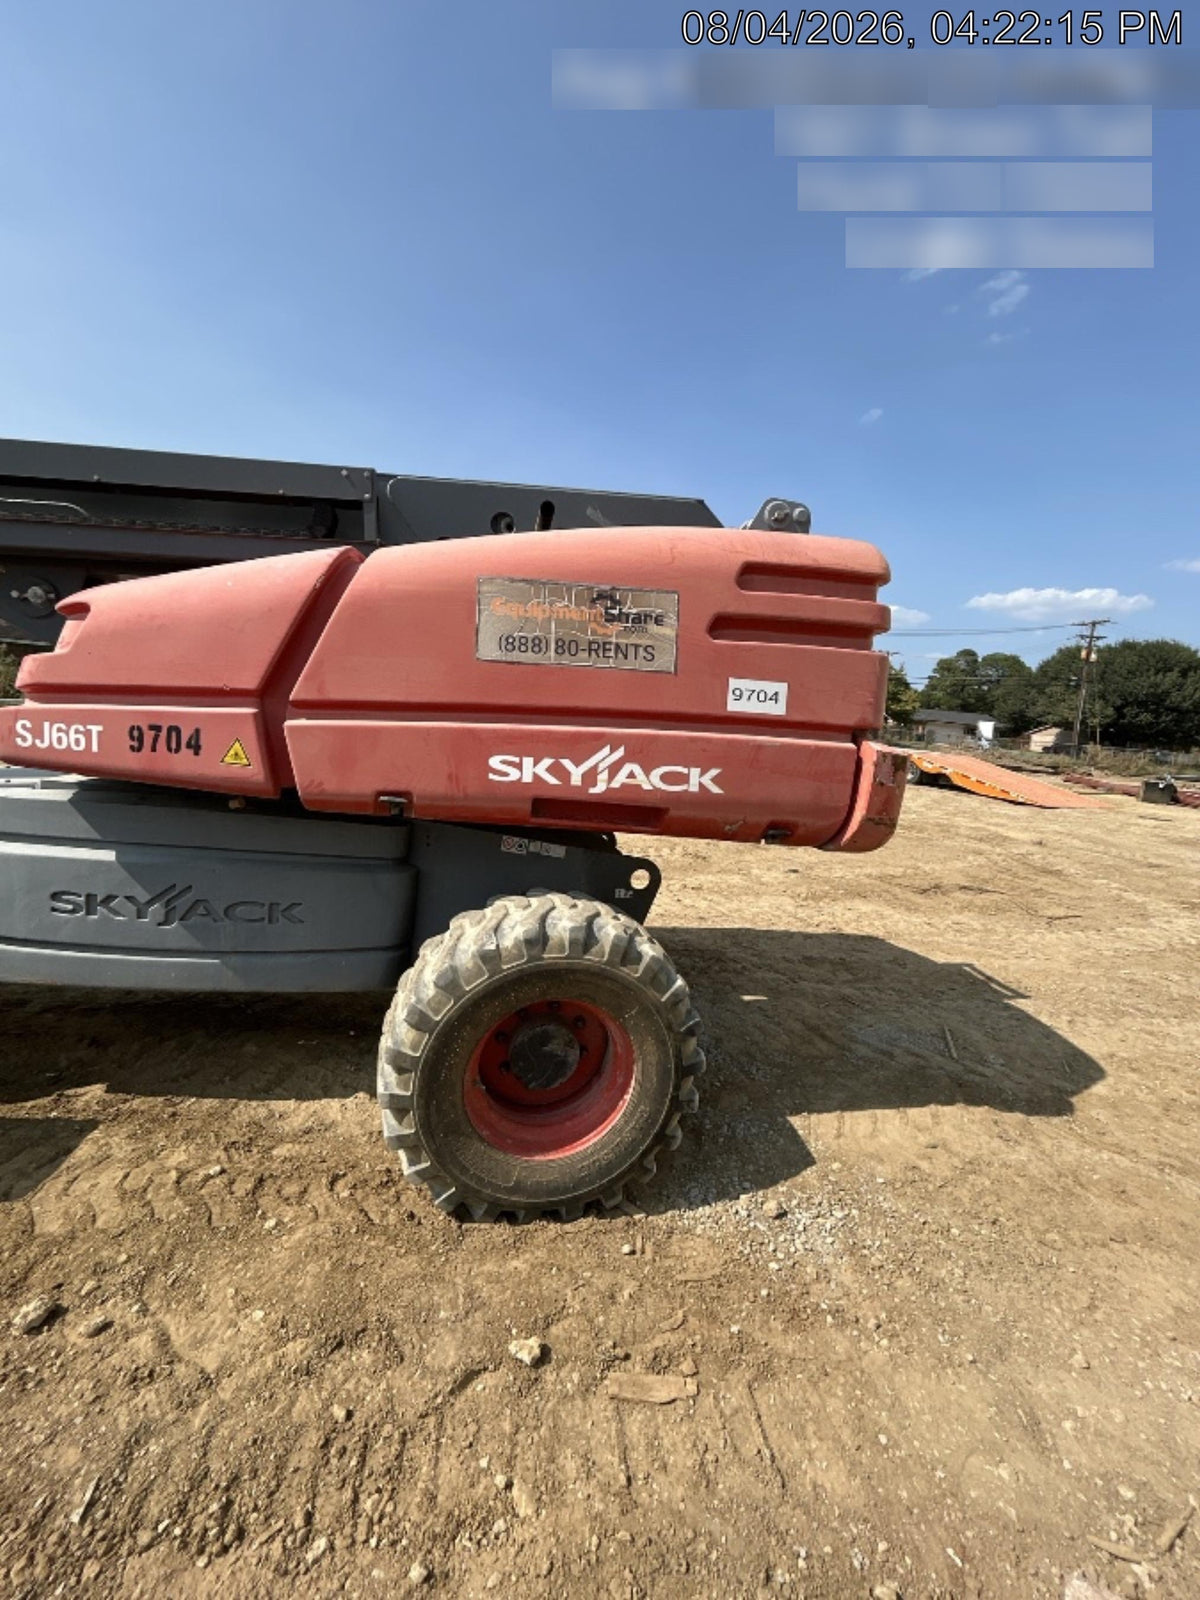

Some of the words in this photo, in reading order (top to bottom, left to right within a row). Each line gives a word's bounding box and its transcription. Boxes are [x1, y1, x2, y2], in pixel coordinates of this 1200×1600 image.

[499, 634, 548, 655] (888)
[554, 638, 656, 662] 80-RENTS
[731, 686, 780, 705] 9704
[15, 719, 103, 753] SJ66T
[128, 724, 202, 756] 9704
[488, 743, 725, 794] SKYJACK
[49, 882, 305, 929] SKYJACK
